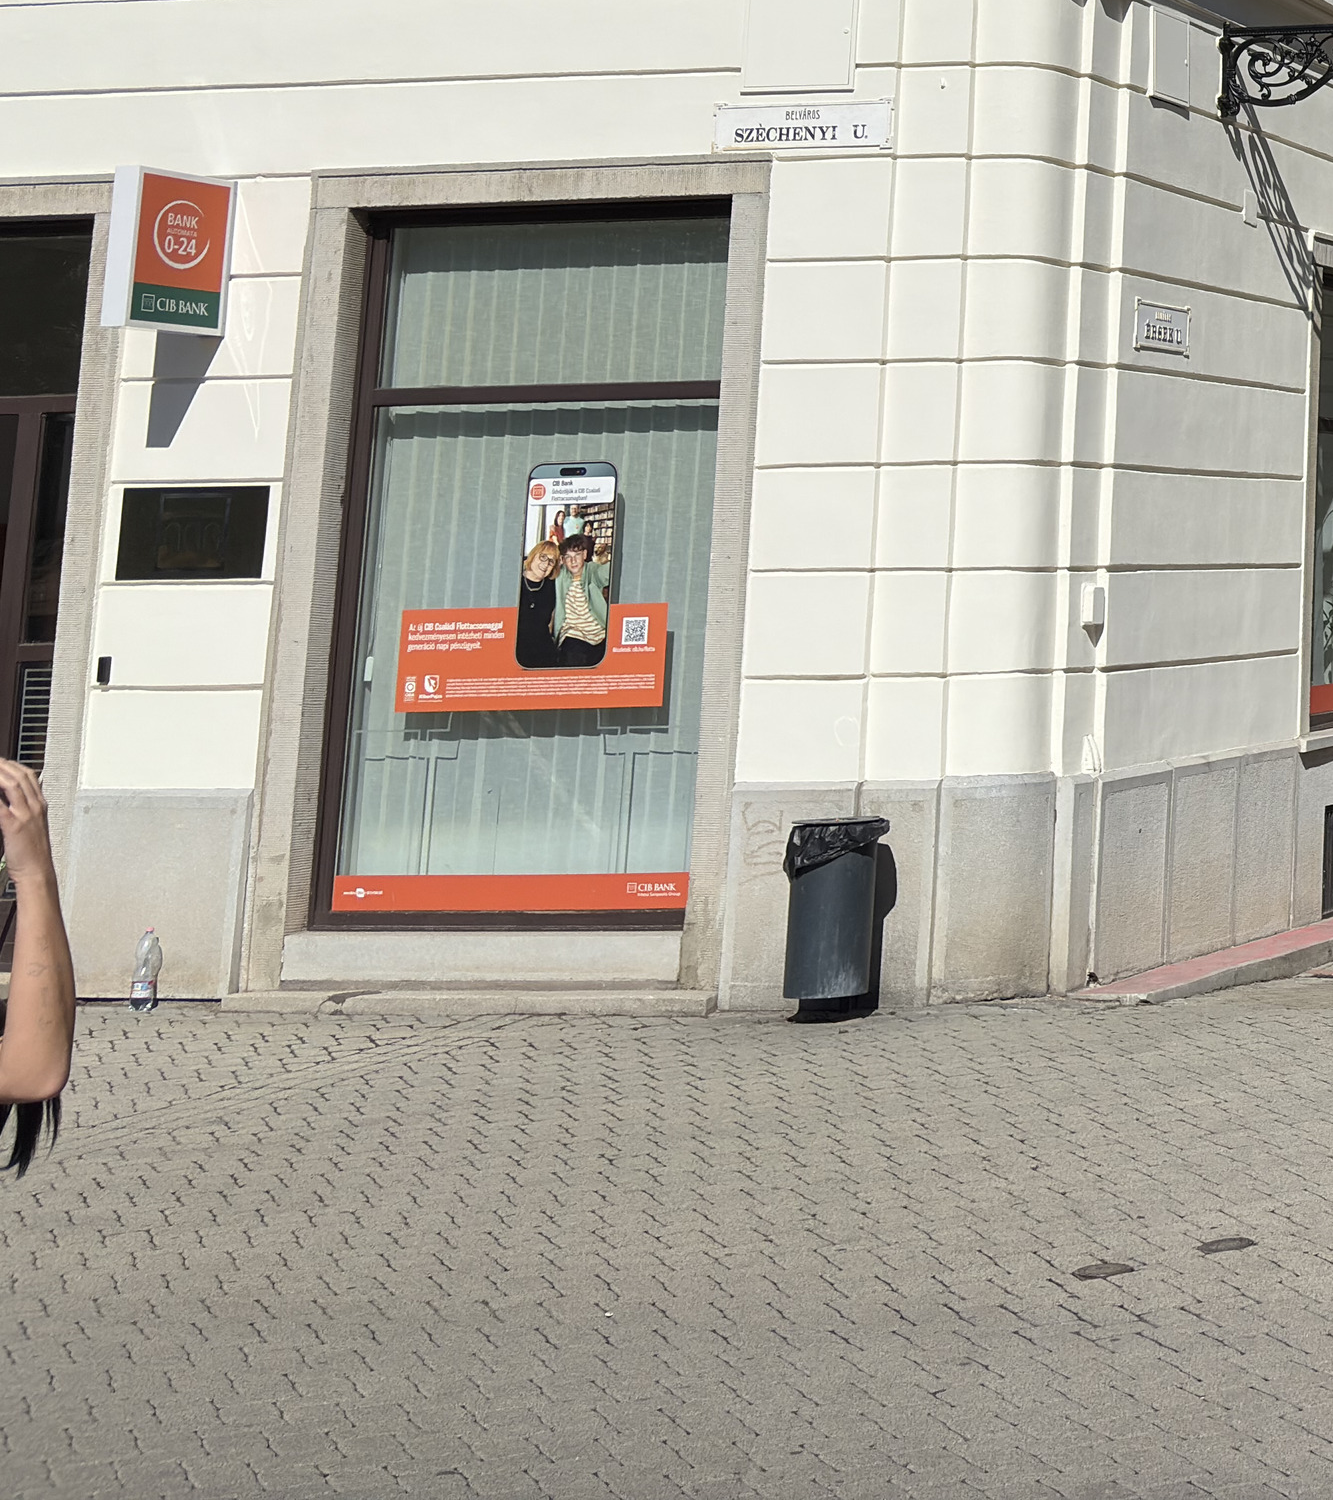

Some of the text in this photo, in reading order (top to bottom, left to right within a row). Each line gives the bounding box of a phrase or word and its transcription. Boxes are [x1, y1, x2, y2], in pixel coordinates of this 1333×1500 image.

[785, 108, 821, 120] BELVÁROS
[852, 124, 868, 140] U.
[167, 212, 199, 229] BANK
[166, 228, 198, 238] AUTOMATA
[164, 236, 197, 256] 0-24
[156, 298, 209, 316] CIB BANK
[424, 622, 434, 631] CIB
[637, 883, 676, 891] CIB BANK
